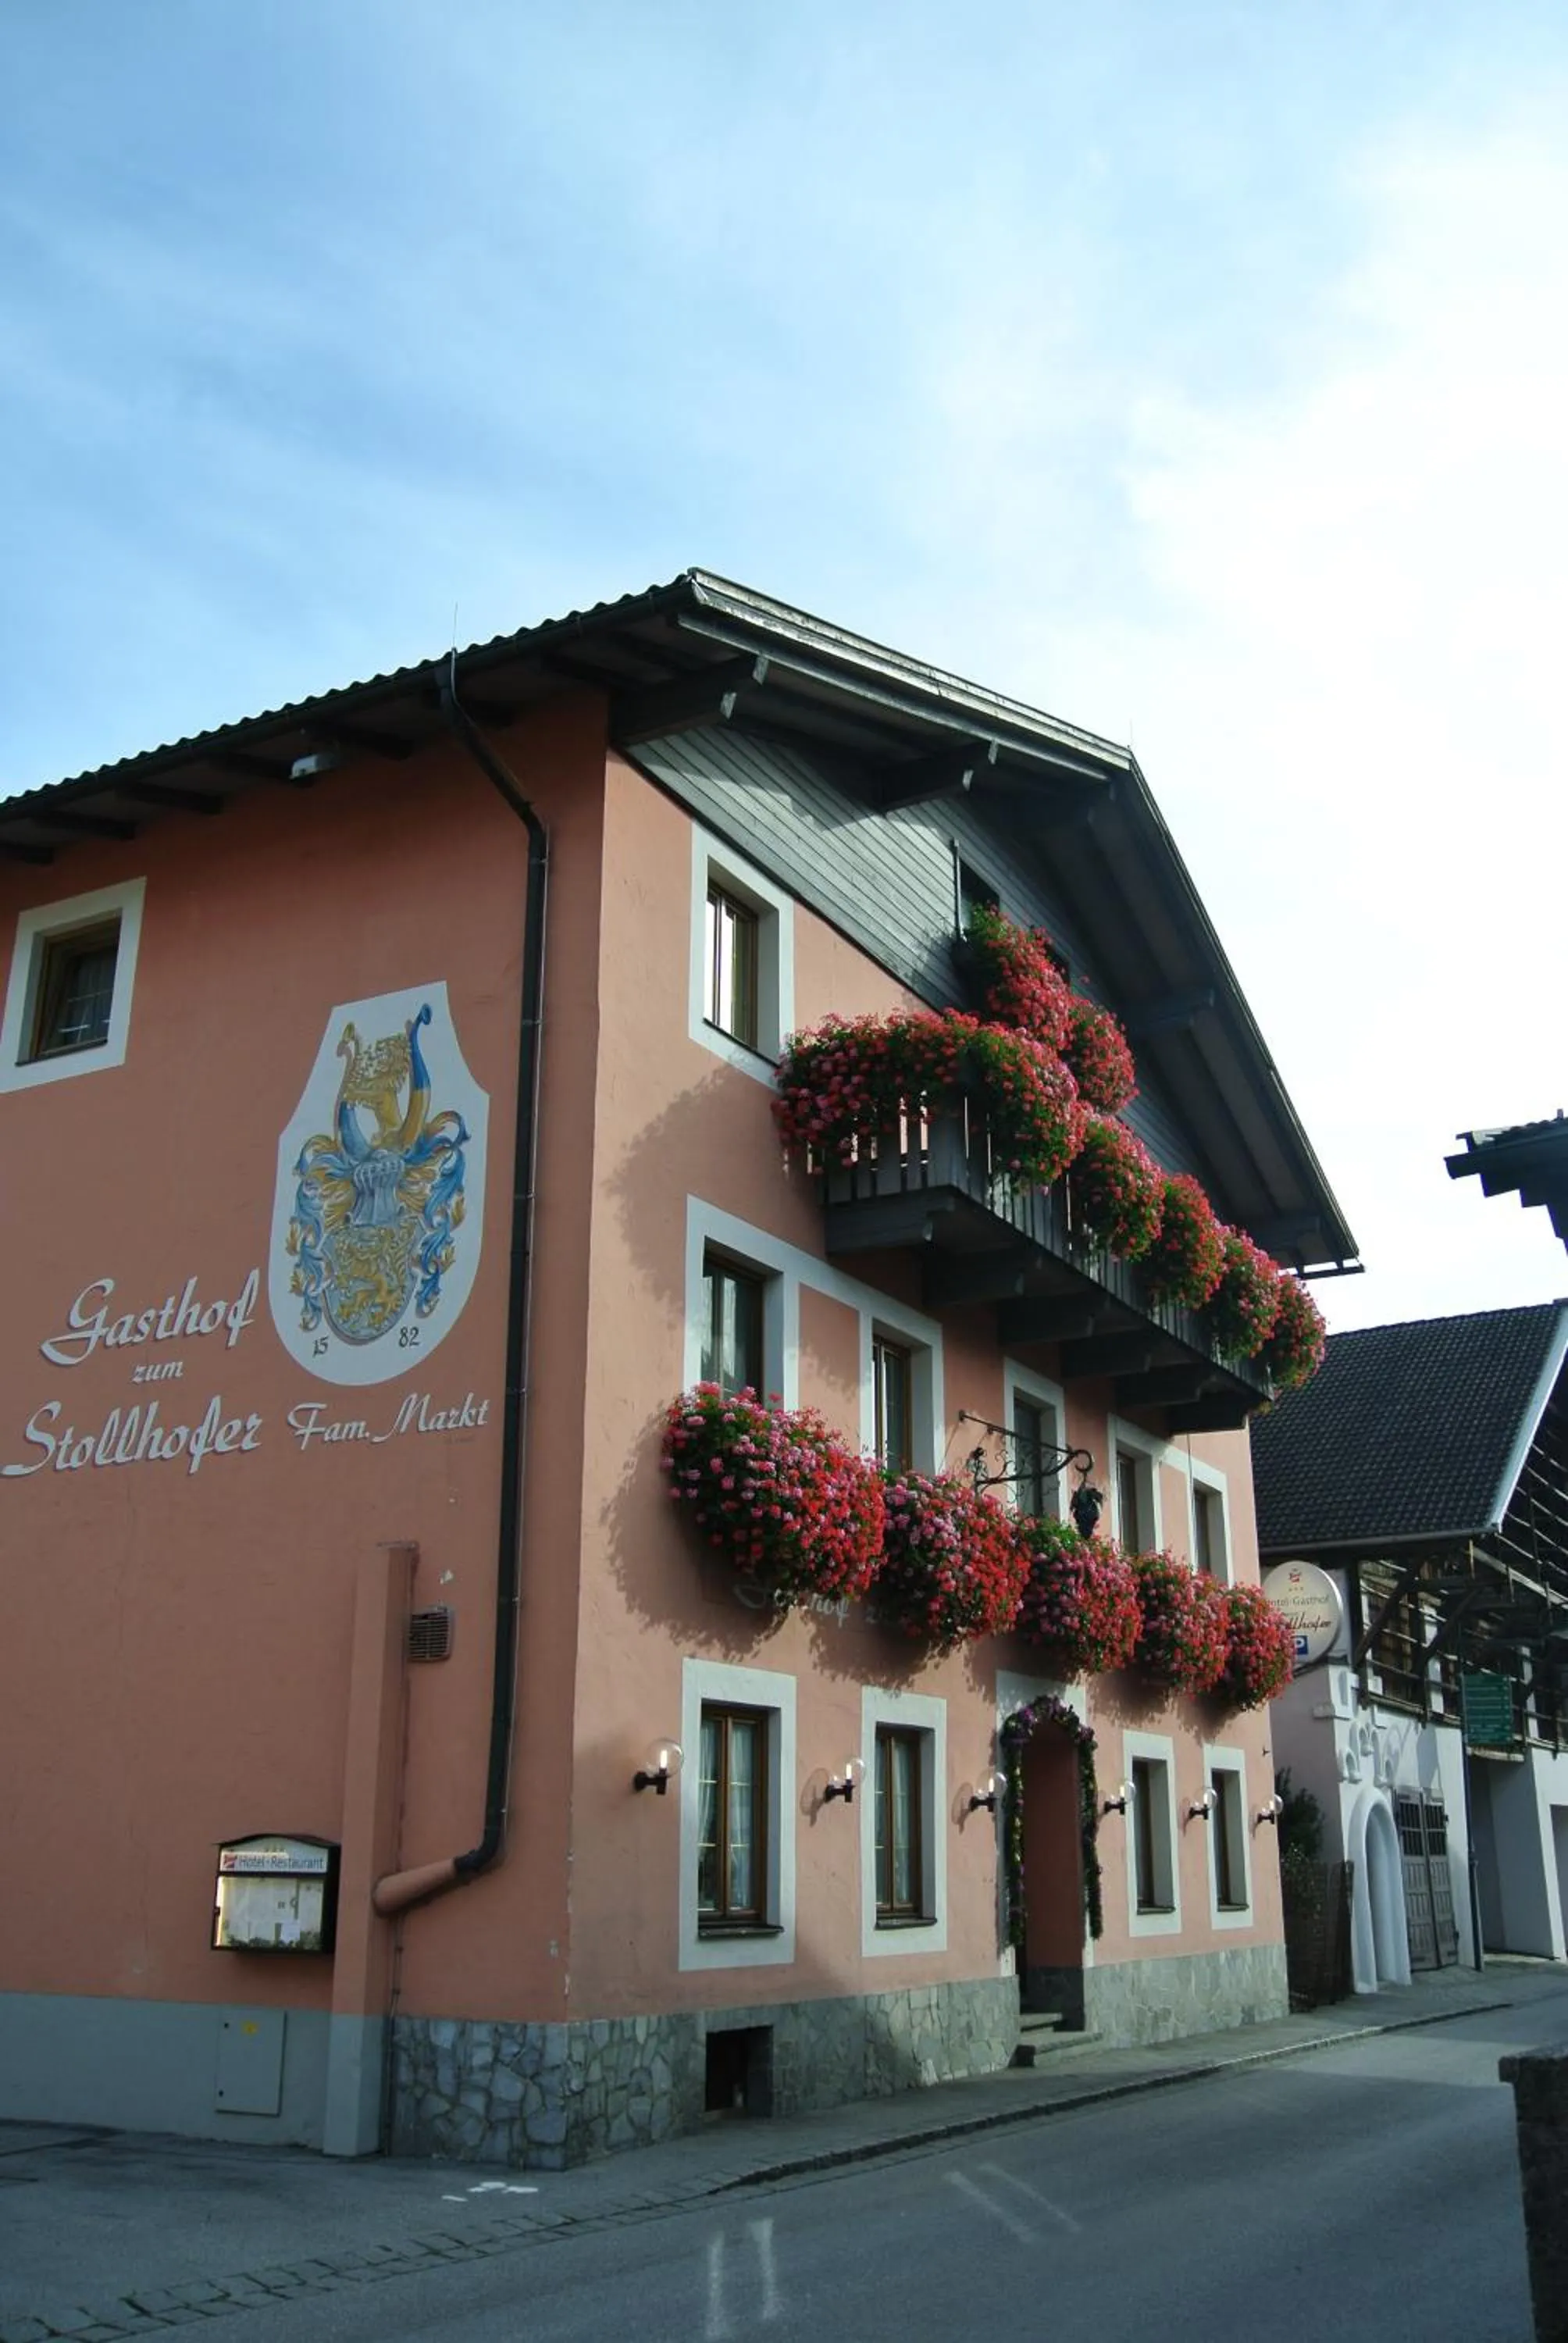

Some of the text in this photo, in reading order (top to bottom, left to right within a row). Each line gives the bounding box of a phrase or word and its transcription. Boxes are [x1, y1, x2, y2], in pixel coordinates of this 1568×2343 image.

[40, 1268, 260, 1366] Gasthof
[312, 1327, 422, 1357] 15 82
[131, 1361, 184, 1384] zum
[1, 1395, 263, 1476] Stollhofer
[286, 1392, 490, 1451] Fam. Markt
